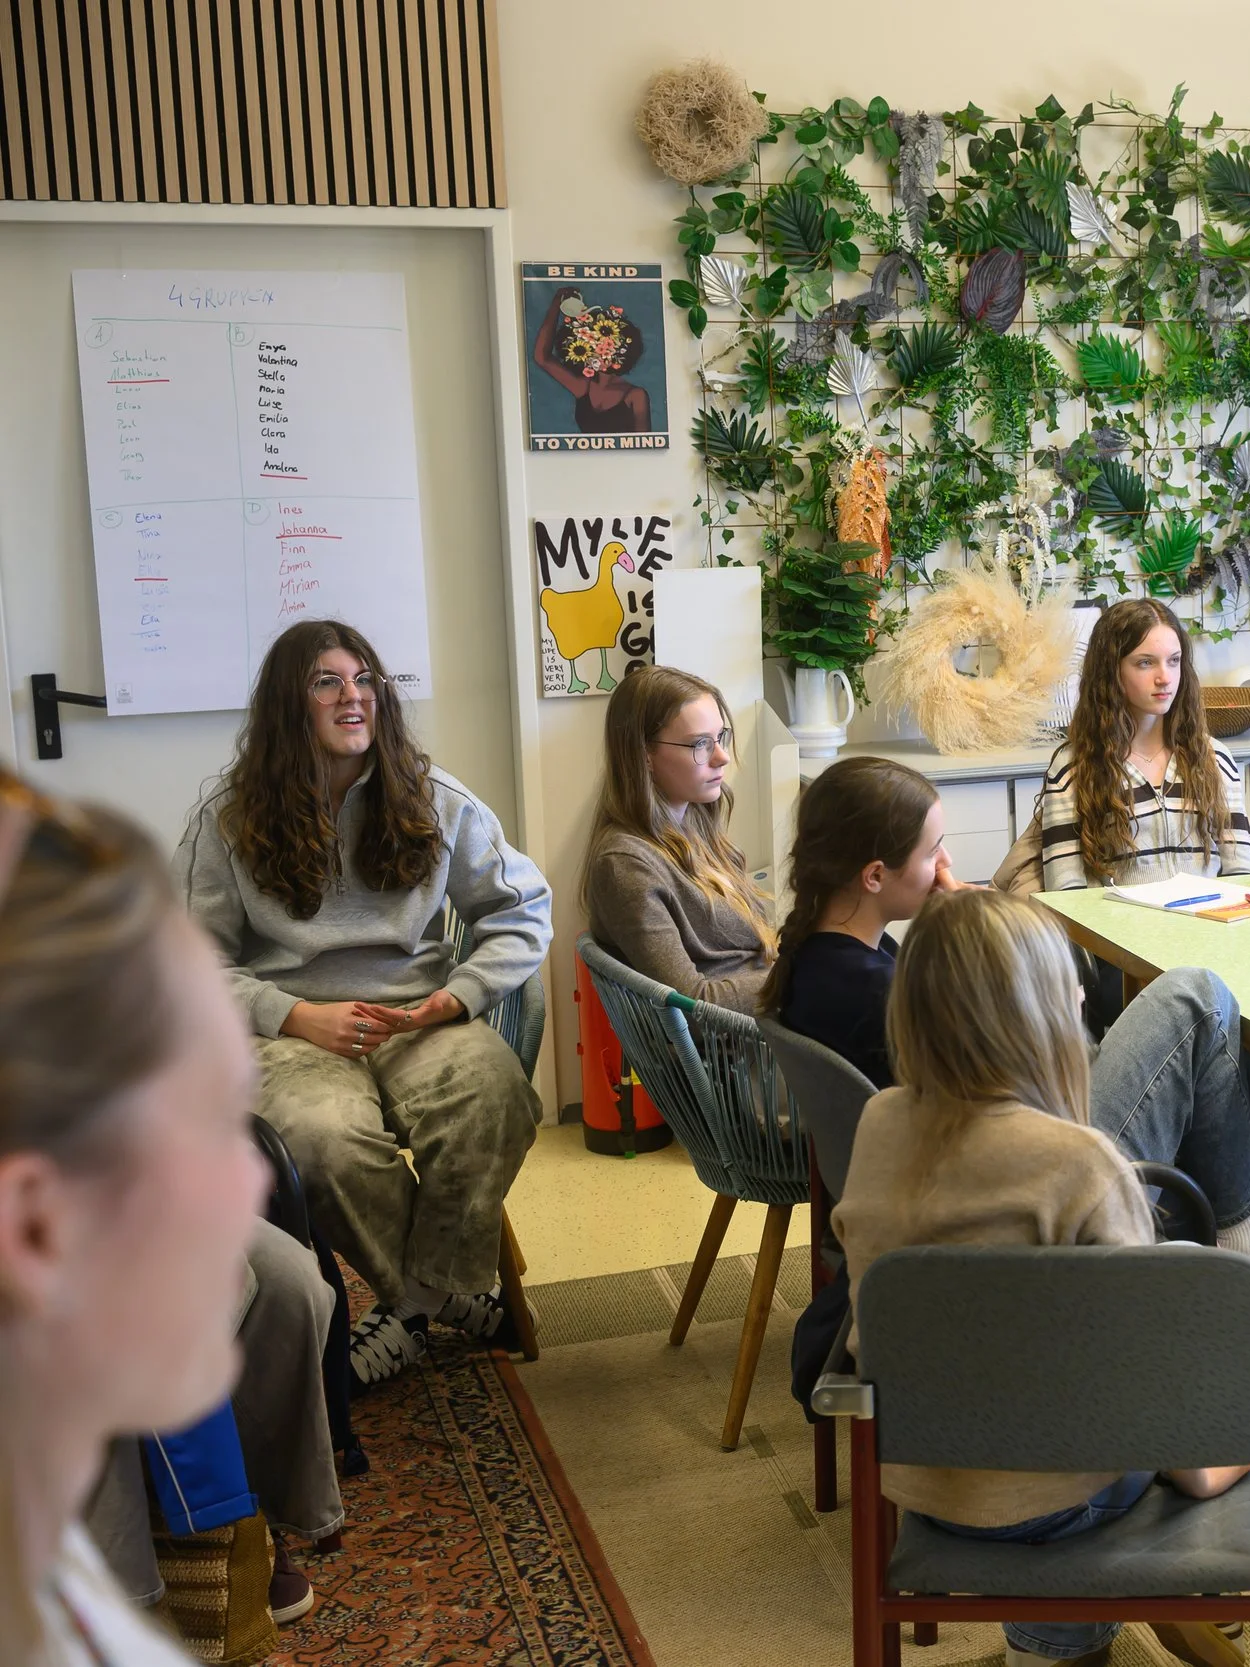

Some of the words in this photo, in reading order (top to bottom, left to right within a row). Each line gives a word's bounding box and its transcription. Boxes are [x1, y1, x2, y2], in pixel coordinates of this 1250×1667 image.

[548, 266, 576, 278] BE
[583, 266, 639, 278] KIND
[258, 354, 298, 368] Valentina
[258, 368, 286, 383] Stella
[259, 412, 289, 424] Emilia
[260, 428, 286, 438] Clara
[264, 442, 280, 454] Ida
[536, 437, 561, 450] TO
[564, 437, 616, 450] YOUR
[620, 436, 666, 450] MIND
[278, 502, 303, 514] Ines
[279, 521, 328, 536] Johanna
[280, 541, 306, 555] Finn
[535, 517, 604, 587] MY
[278, 560, 312, 576] Emma
[280, 578, 321, 596] Miriam
[542, 638, 553, 648] MY
[544, 664, 564, 672] VERY
[544, 674, 564, 682] VERY
